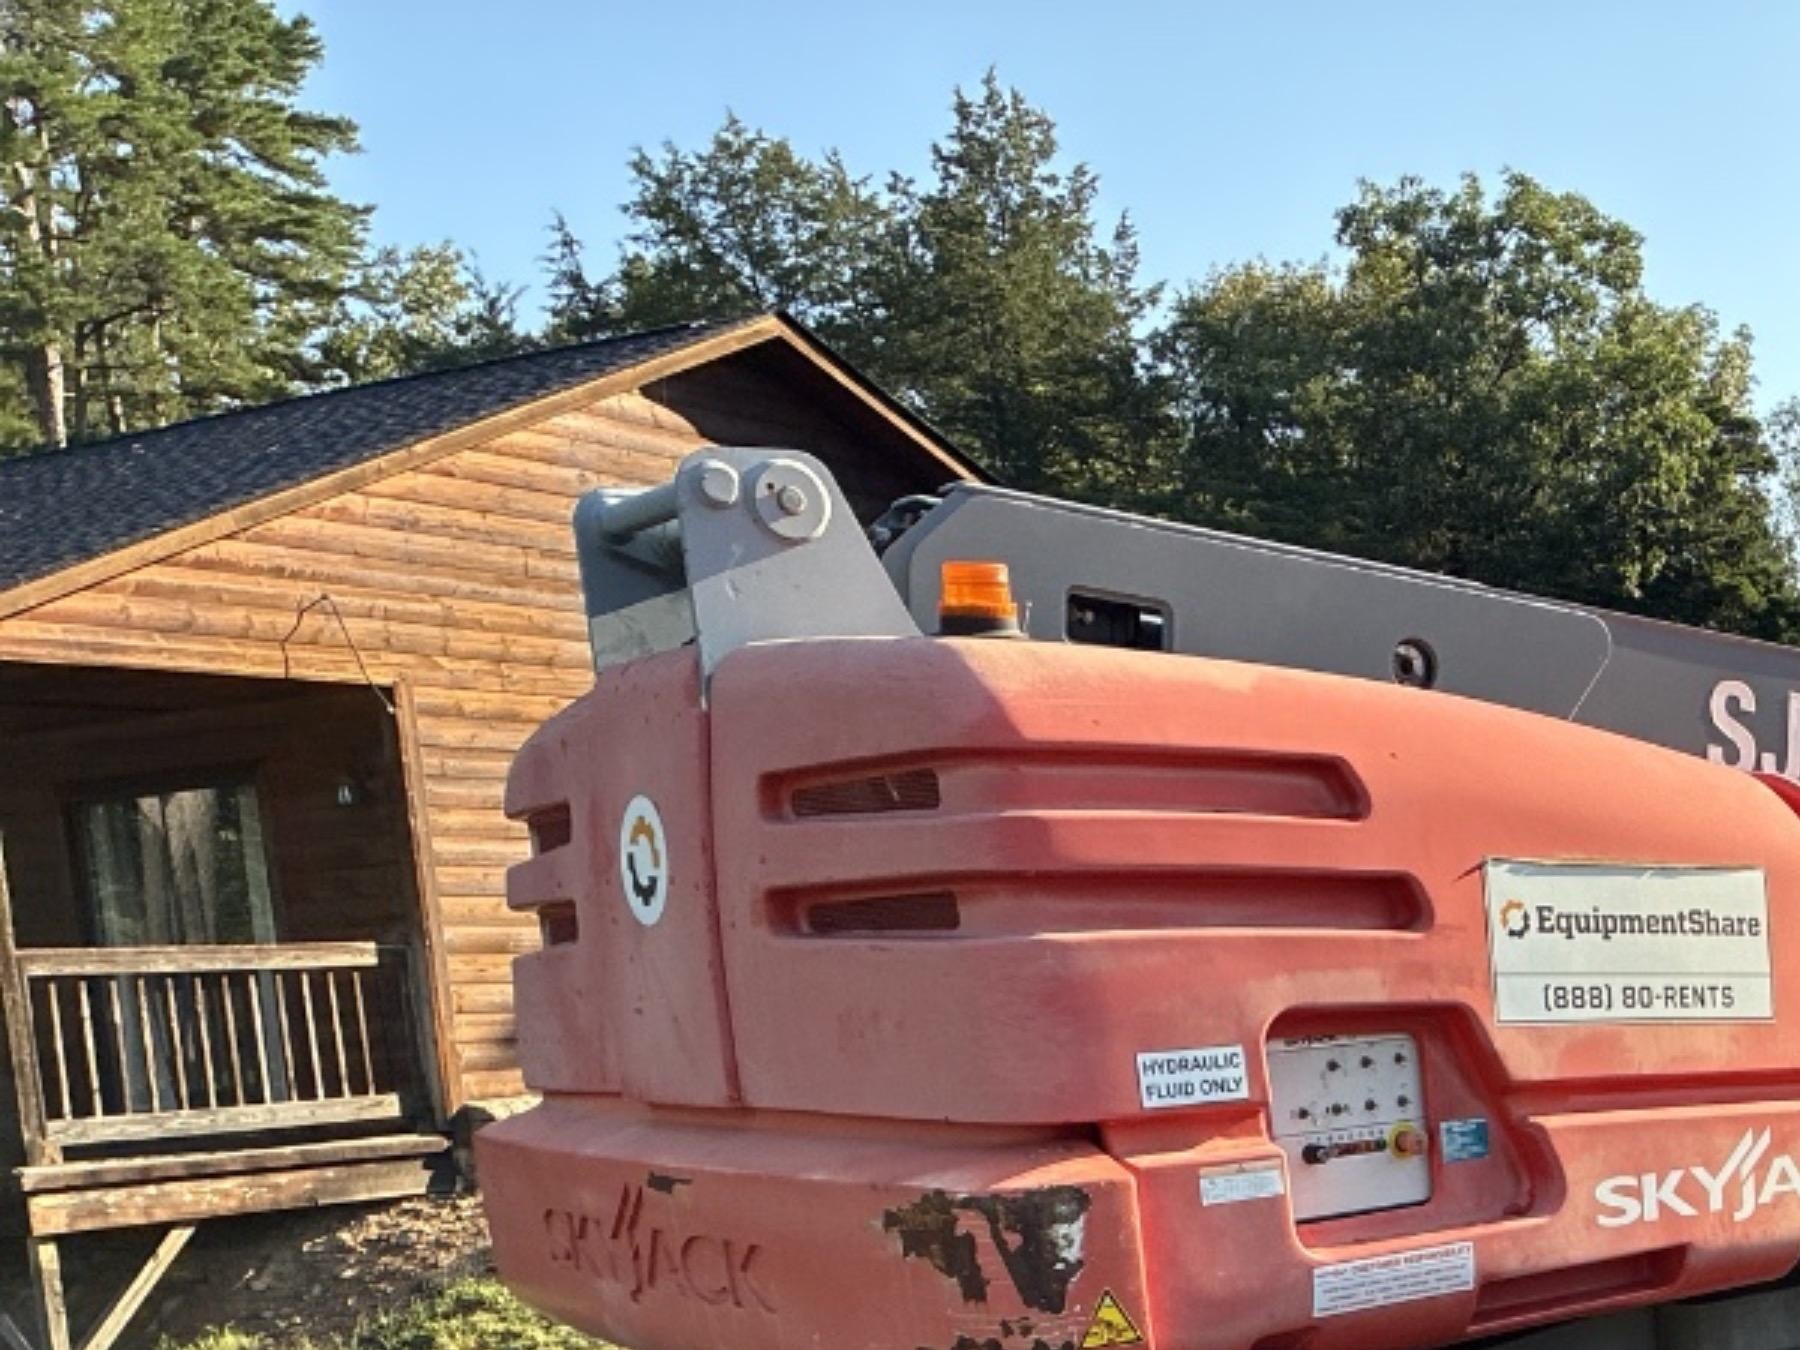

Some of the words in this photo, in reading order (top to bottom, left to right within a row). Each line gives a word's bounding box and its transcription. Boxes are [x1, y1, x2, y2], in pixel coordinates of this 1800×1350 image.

[1535, 904, 1761, 940] EquipmentShare
[1544, 984, 1613, 1011] (888)
[1622, 985, 1735, 1010] 80-RENTS
[1143, 1052, 1242, 1076] HYDRAULIC
[1145, 1081, 1195, 1102] FLUID
[1200, 1077, 1242, 1096] ONLY
[543, 1182, 777, 1314] SKYJACK
